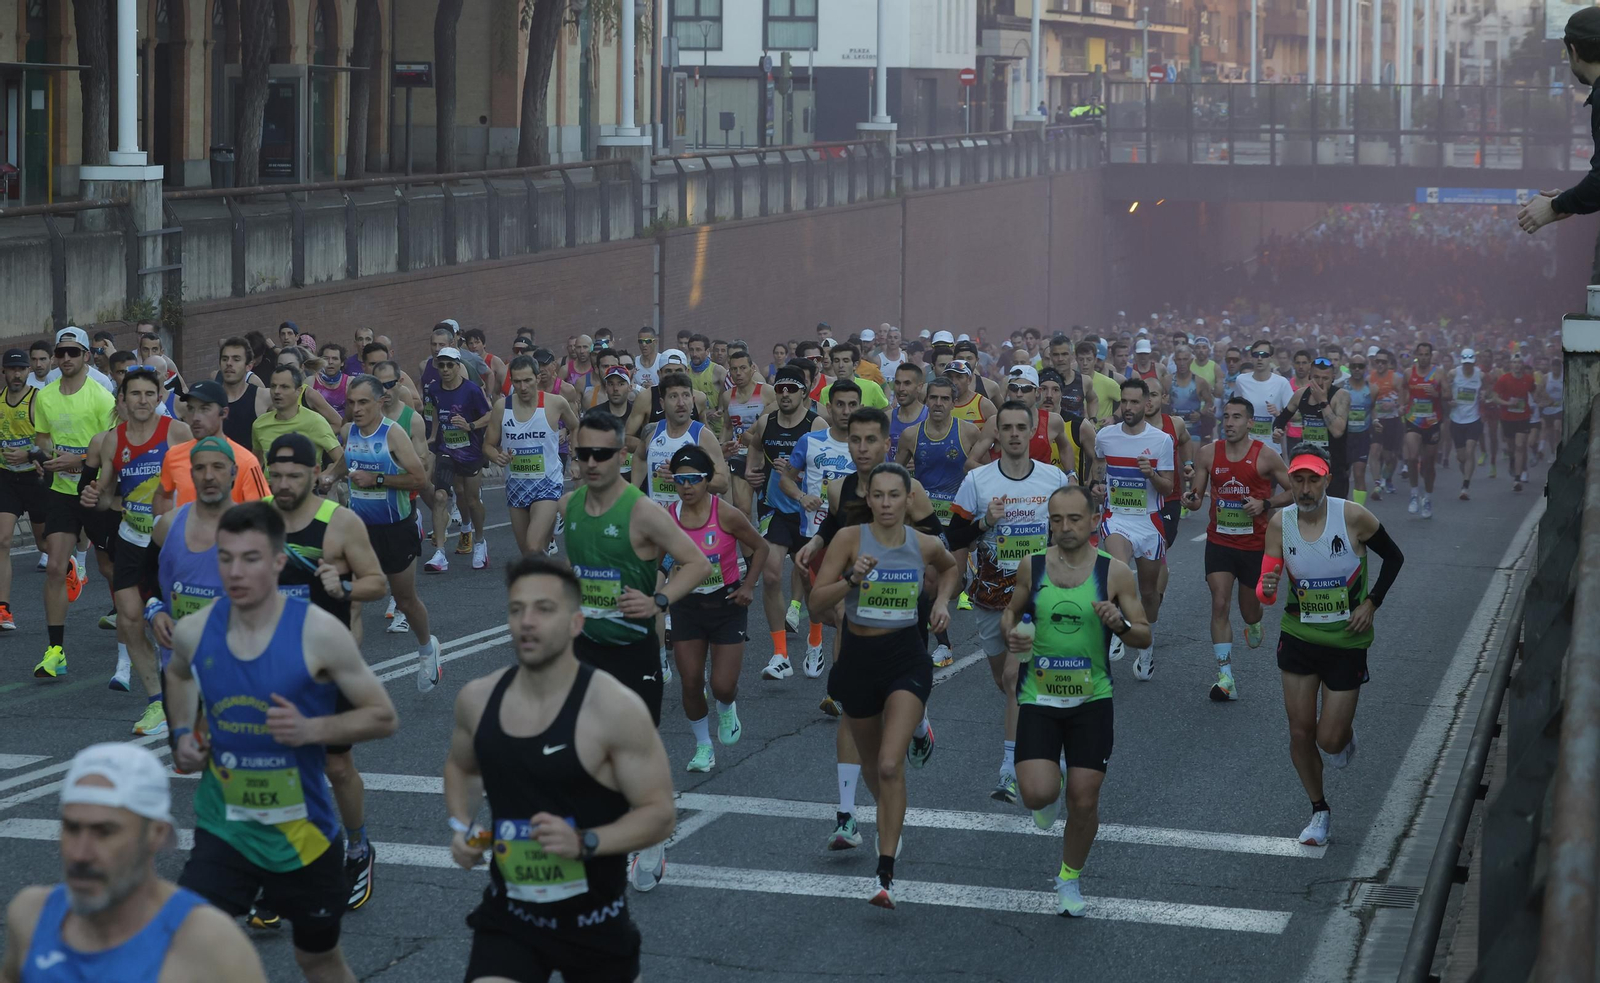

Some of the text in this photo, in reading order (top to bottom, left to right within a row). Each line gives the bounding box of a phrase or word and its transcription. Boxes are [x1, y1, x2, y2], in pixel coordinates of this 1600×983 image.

[505, 431, 546, 440] FRANCE
[360, 462, 380, 470] ZURICH
[814, 453, 849, 470] Family
[121, 465, 161, 477] PALACIEGO
[513, 464, 540, 472] FABRICE
[931, 492, 951, 500] ZURICH
[992, 495, 1047, 505] Rnningzgz
[1113, 497, 1143, 507] JUANMA
[1005, 508, 1036, 518] pelsue
[1014, 526, 1040, 535] ZURICH
[1000, 549, 1030, 560] MARIO
[584, 569, 614, 578] ZURICH
[881, 572, 913, 580] ZURICH
[1312, 579, 1341, 588] ZURICH
[185, 585, 215, 598] ZURICH
[881, 587, 898, 595] 2431
[185, 601, 200, 610] 1752
[868, 596, 909, 608] GOATER
[1301, 600, 1348, 612] SERGIO M.
[1053, 659, 1084, 668] ZURICH
[1054, 674, 1072, 683] 2049
[1046, 683, 1083, 695] VICTOR
[241, 756, 286, 768] ZURICH
[242, 792, 280, 806] ALEX
[514, 864, 565, 882] SALVA
